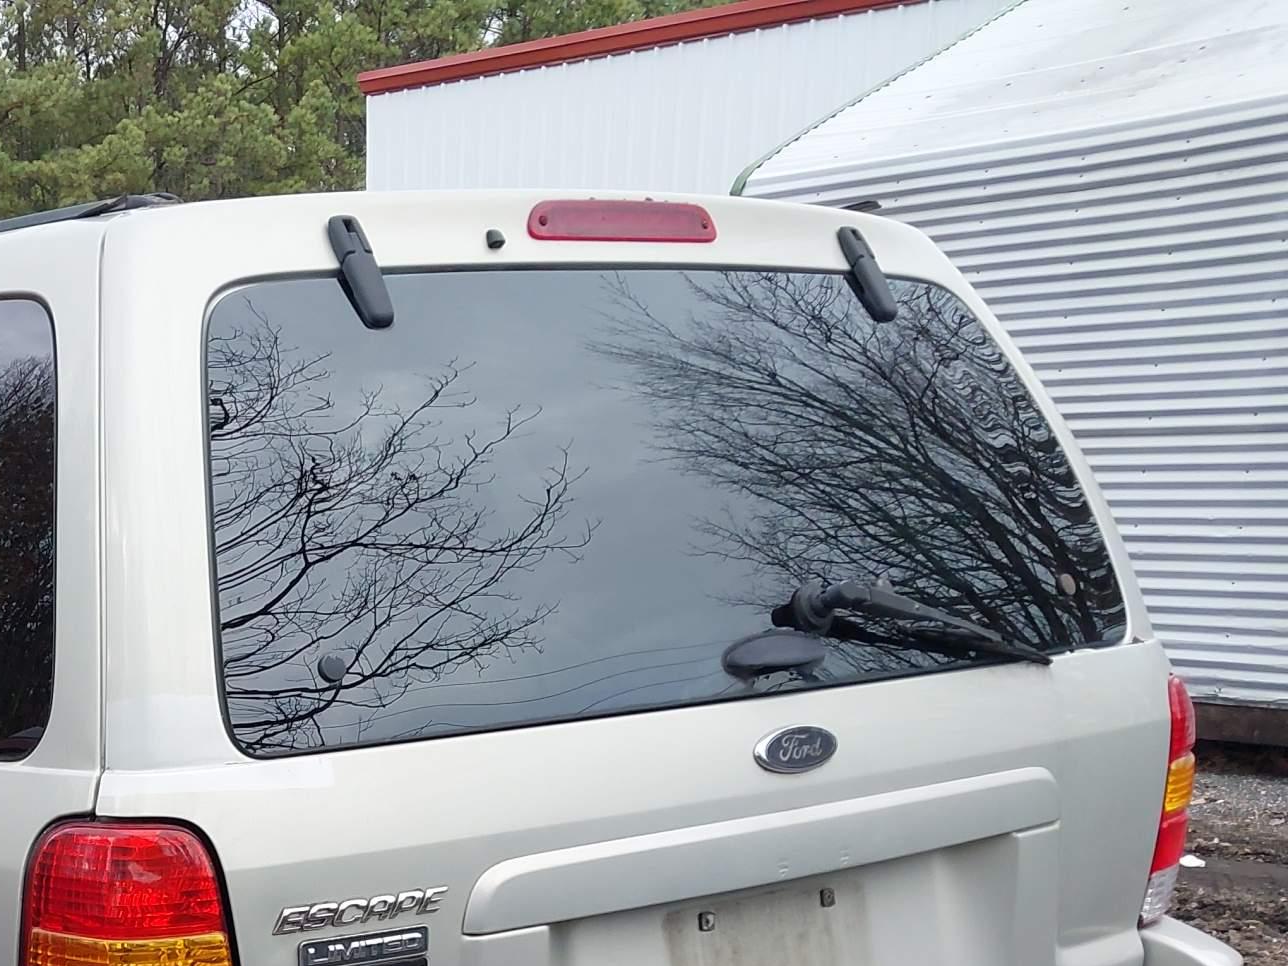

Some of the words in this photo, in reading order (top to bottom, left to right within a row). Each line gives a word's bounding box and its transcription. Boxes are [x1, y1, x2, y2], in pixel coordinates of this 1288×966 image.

[779, 733, 823, 761] Ford
[272, 886, 449, 935] ESCAPE
[307, 932, 423, 966] LIMITED
